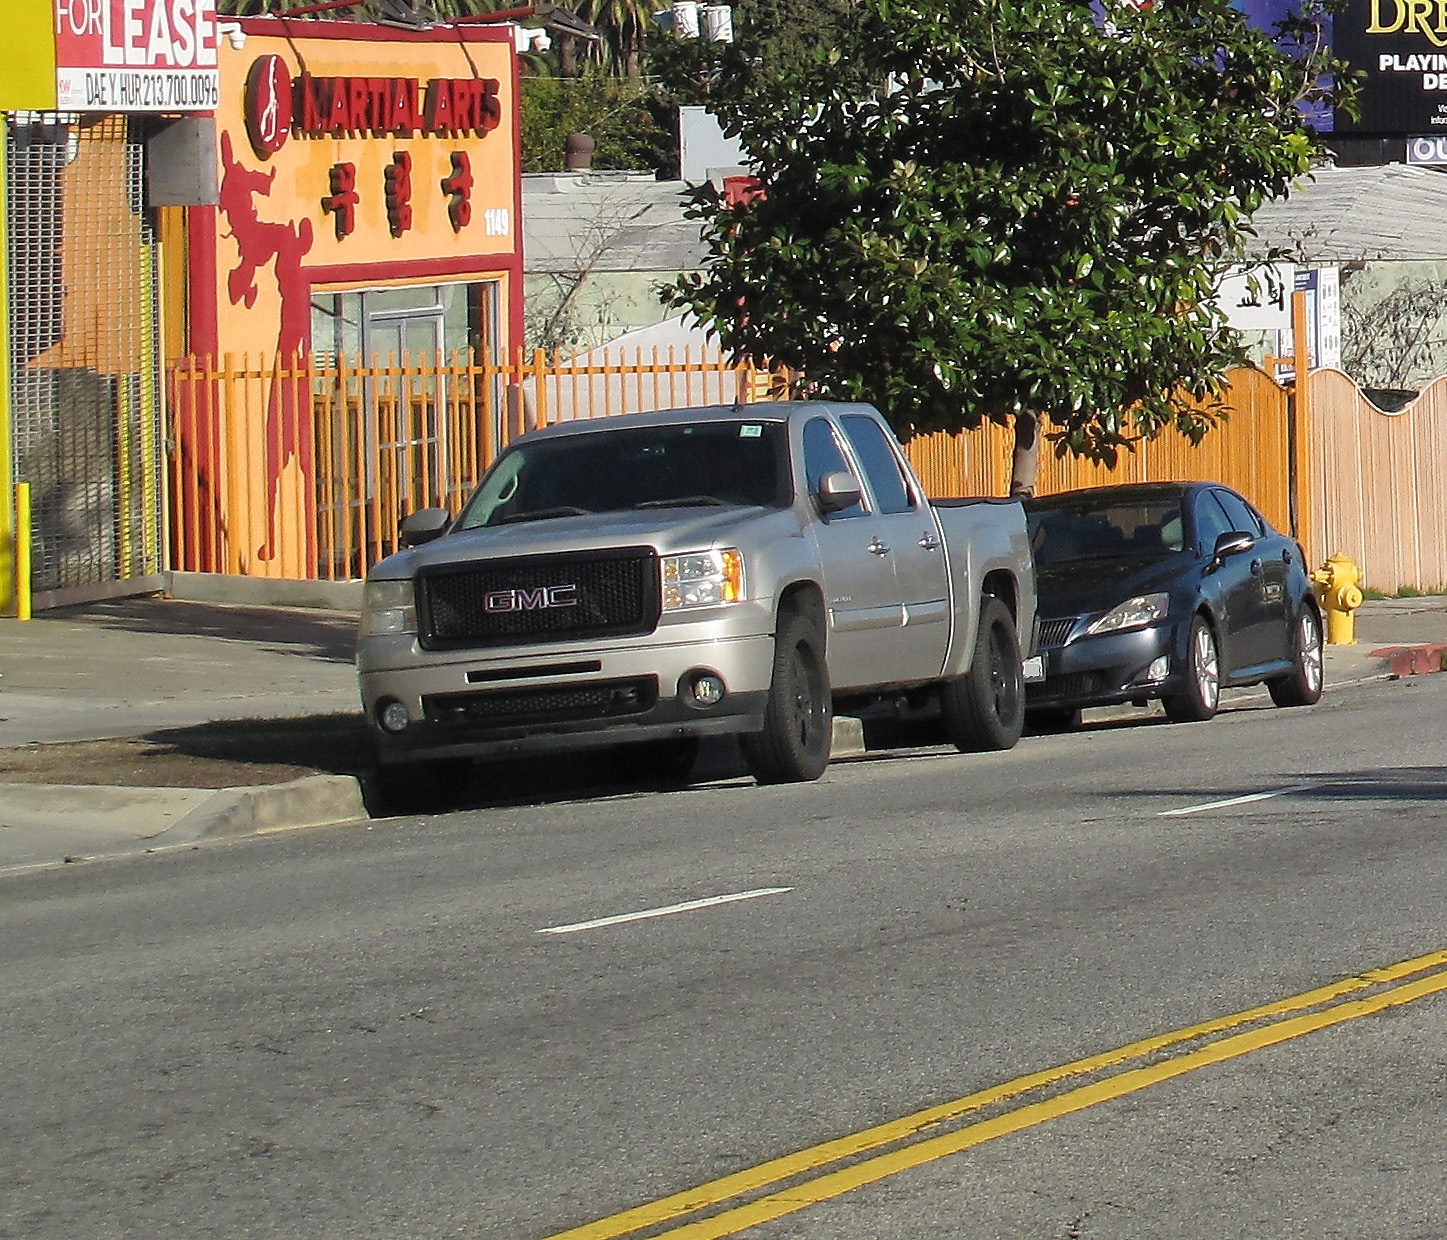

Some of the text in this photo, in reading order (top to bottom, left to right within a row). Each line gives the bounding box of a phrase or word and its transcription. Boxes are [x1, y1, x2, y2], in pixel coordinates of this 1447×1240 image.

[85, 72, 218, 106] DAE Y. HUR 213.700.0096
[293, 77, 500, 138] MARTIAL ARTS
[485, 209, 509, 236] 1149
[485, 584, 577, 613] GMC
